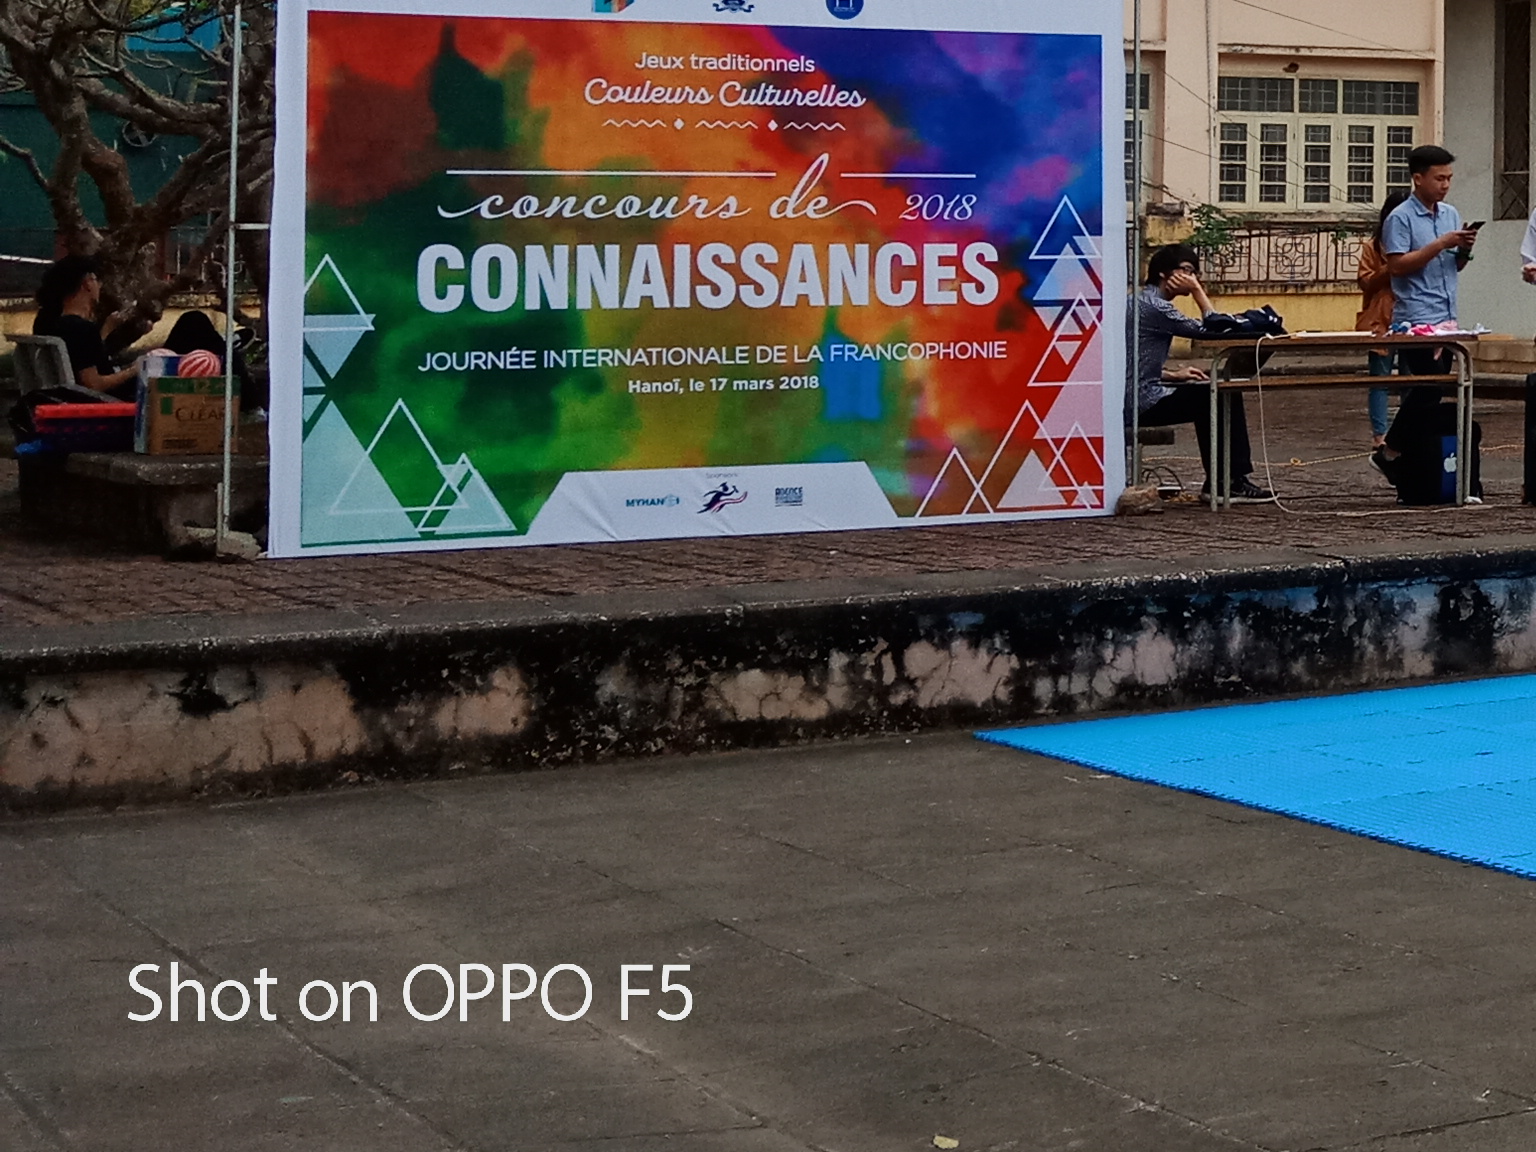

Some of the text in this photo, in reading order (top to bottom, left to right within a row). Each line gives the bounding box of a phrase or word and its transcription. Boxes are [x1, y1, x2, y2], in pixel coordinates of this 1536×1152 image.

[635, 52, 815, 73] Jeux traditionnels
[584, 78, 866, 108] Couleurs Culturelles
[437, 152, 977, 220] concours de 2018
[417, 242, 1000, 313] CONNAISSANCES
[418, 341, 1007, 372] JOURNÉE INTERNATIONALE DE LA FRANCOPHONIE
[628, 376, 819, 395] Hanoï, le 17 mars 2018
